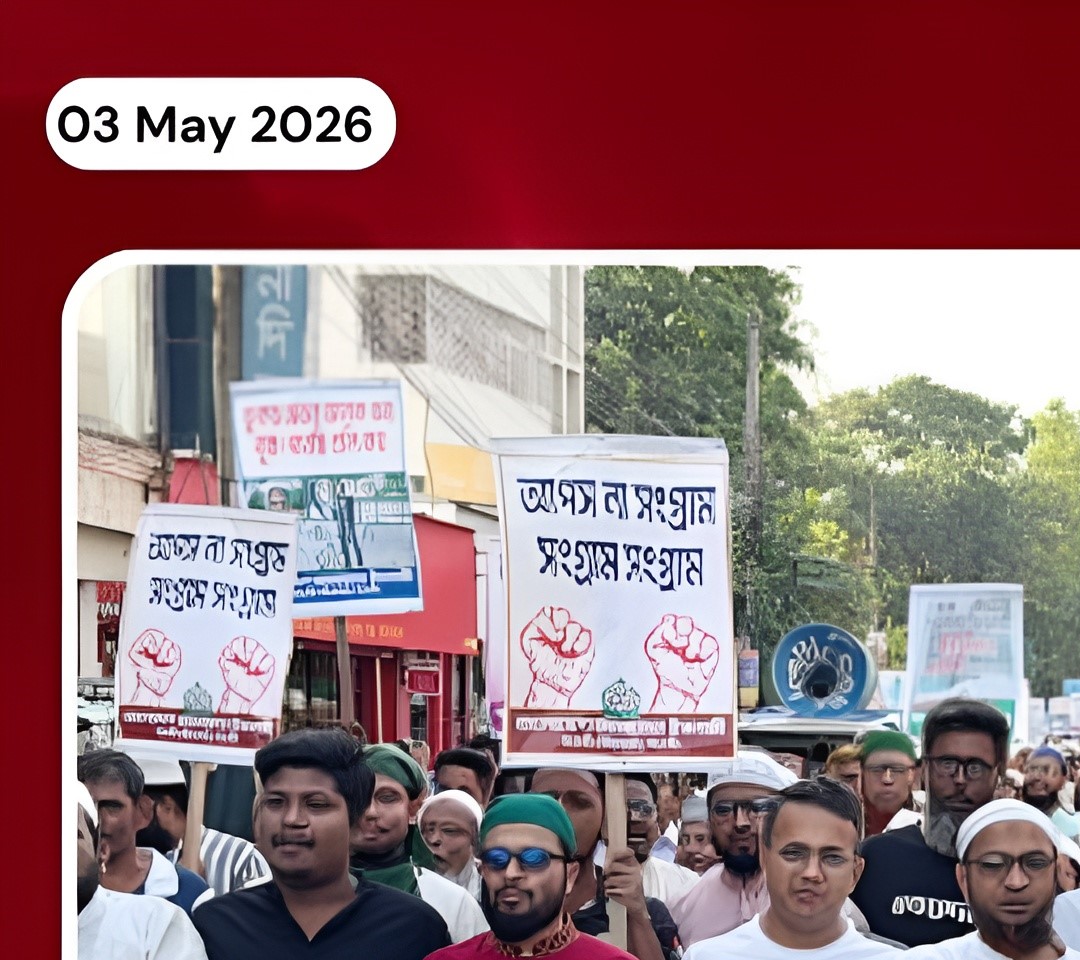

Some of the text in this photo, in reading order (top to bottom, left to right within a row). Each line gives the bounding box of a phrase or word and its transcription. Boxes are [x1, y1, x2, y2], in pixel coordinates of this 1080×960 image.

[601, 481, 629, 520] না
[630, 483, 717, 531] সংগ্রাম
[536, 535, 704, 592] সংগ্রাম সংগ্রাম
